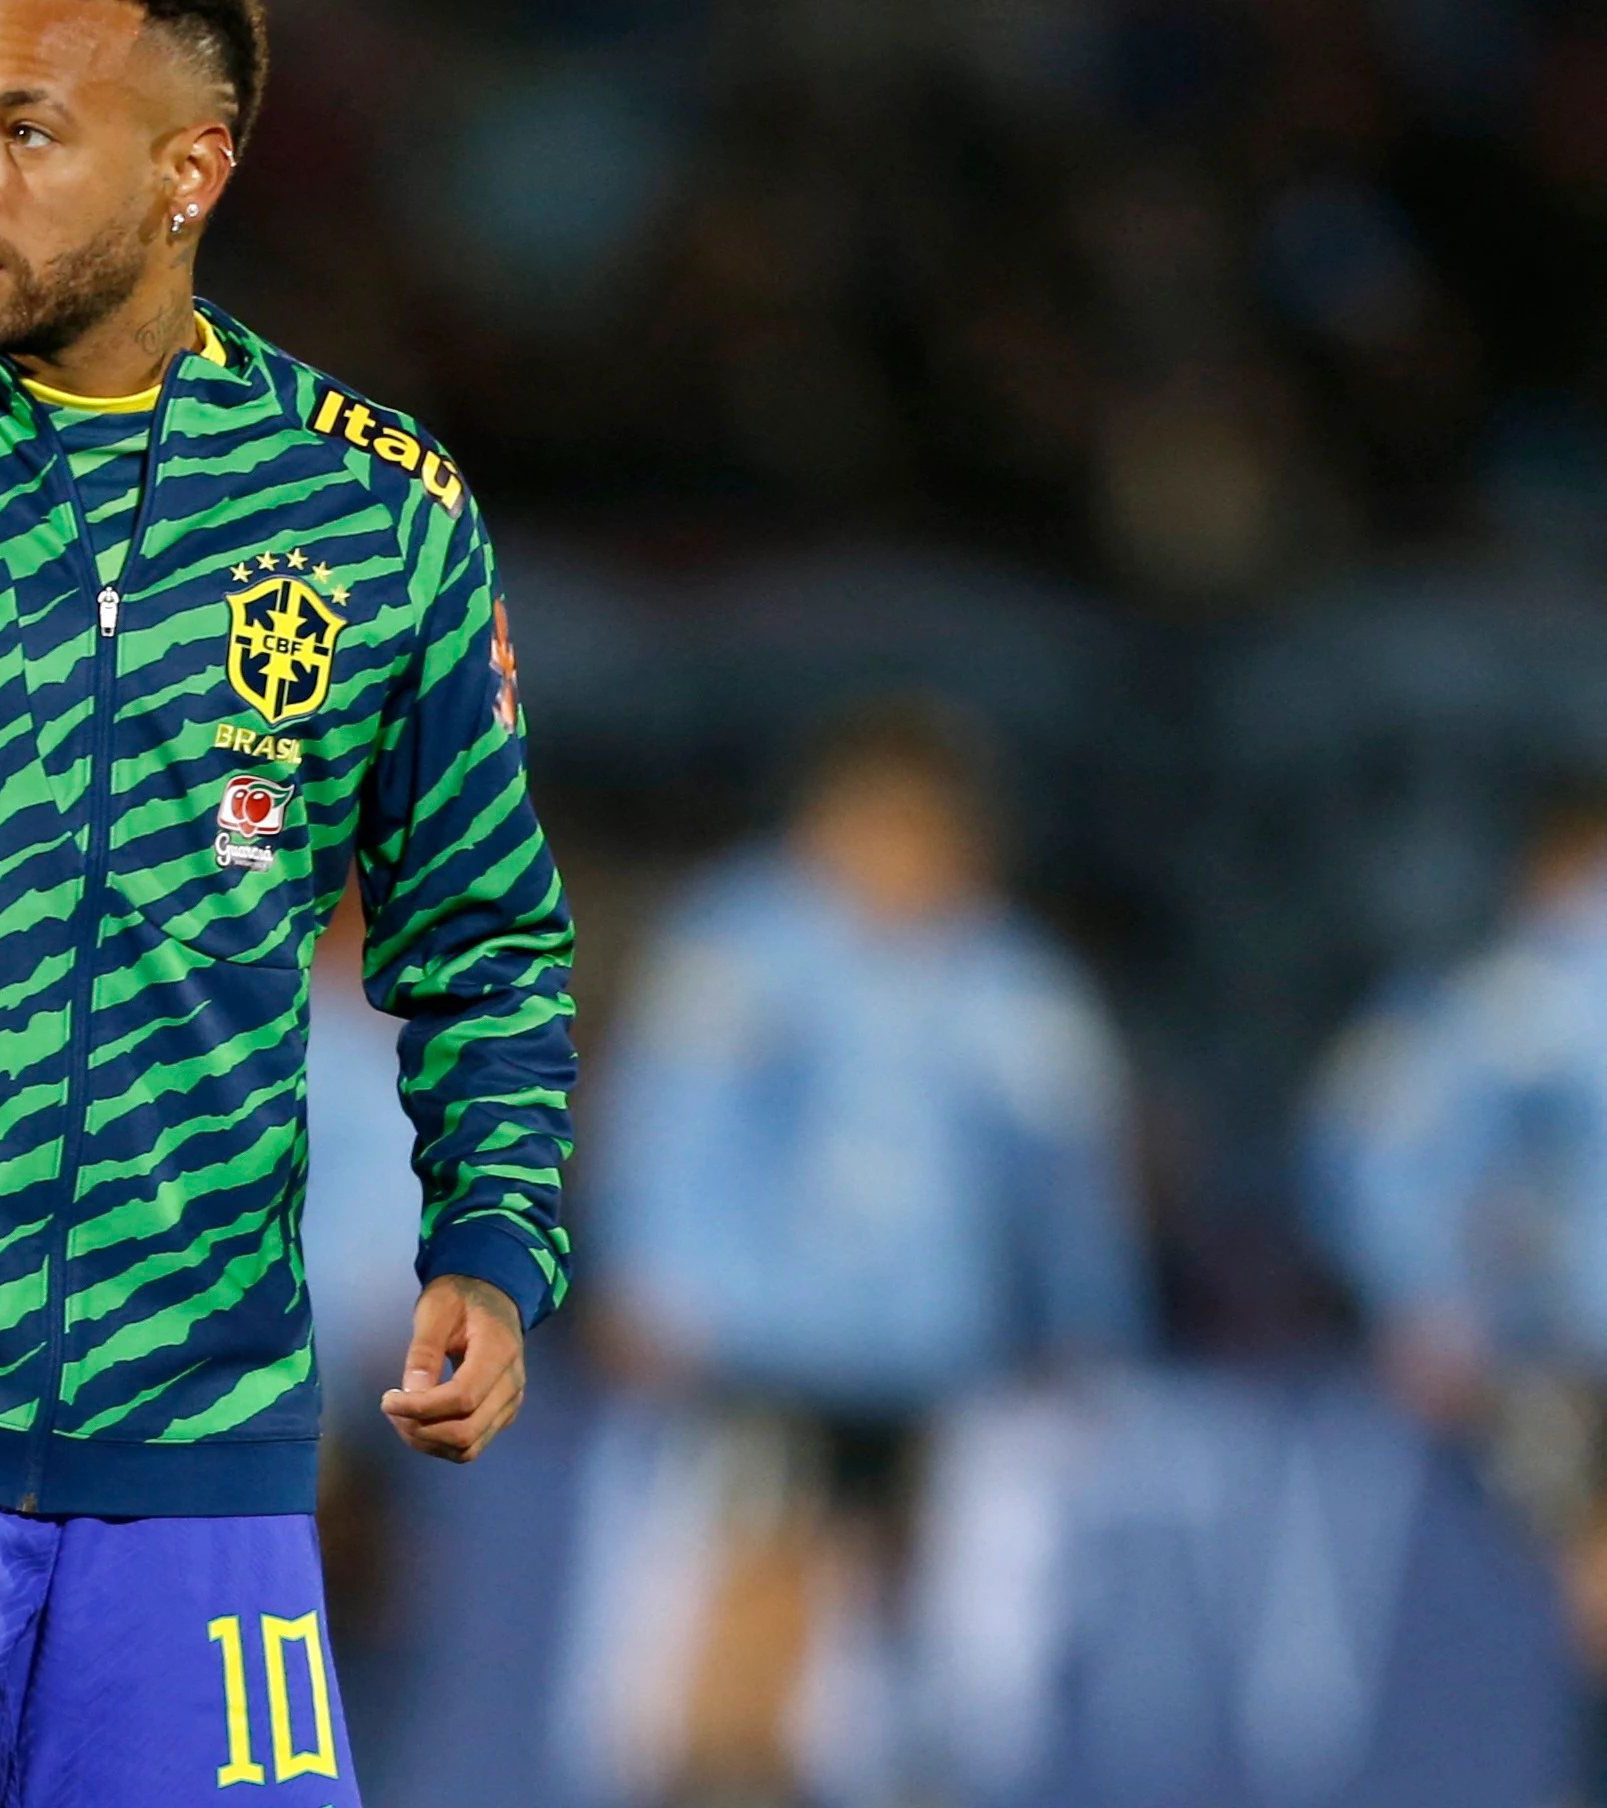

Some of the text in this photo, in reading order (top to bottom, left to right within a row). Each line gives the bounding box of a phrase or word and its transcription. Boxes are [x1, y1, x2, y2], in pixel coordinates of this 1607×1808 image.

[313, 390, 462, 509] Itaú
[262, 634, 302, 656] CBF
[207, 1610, 339, 1789] 10
